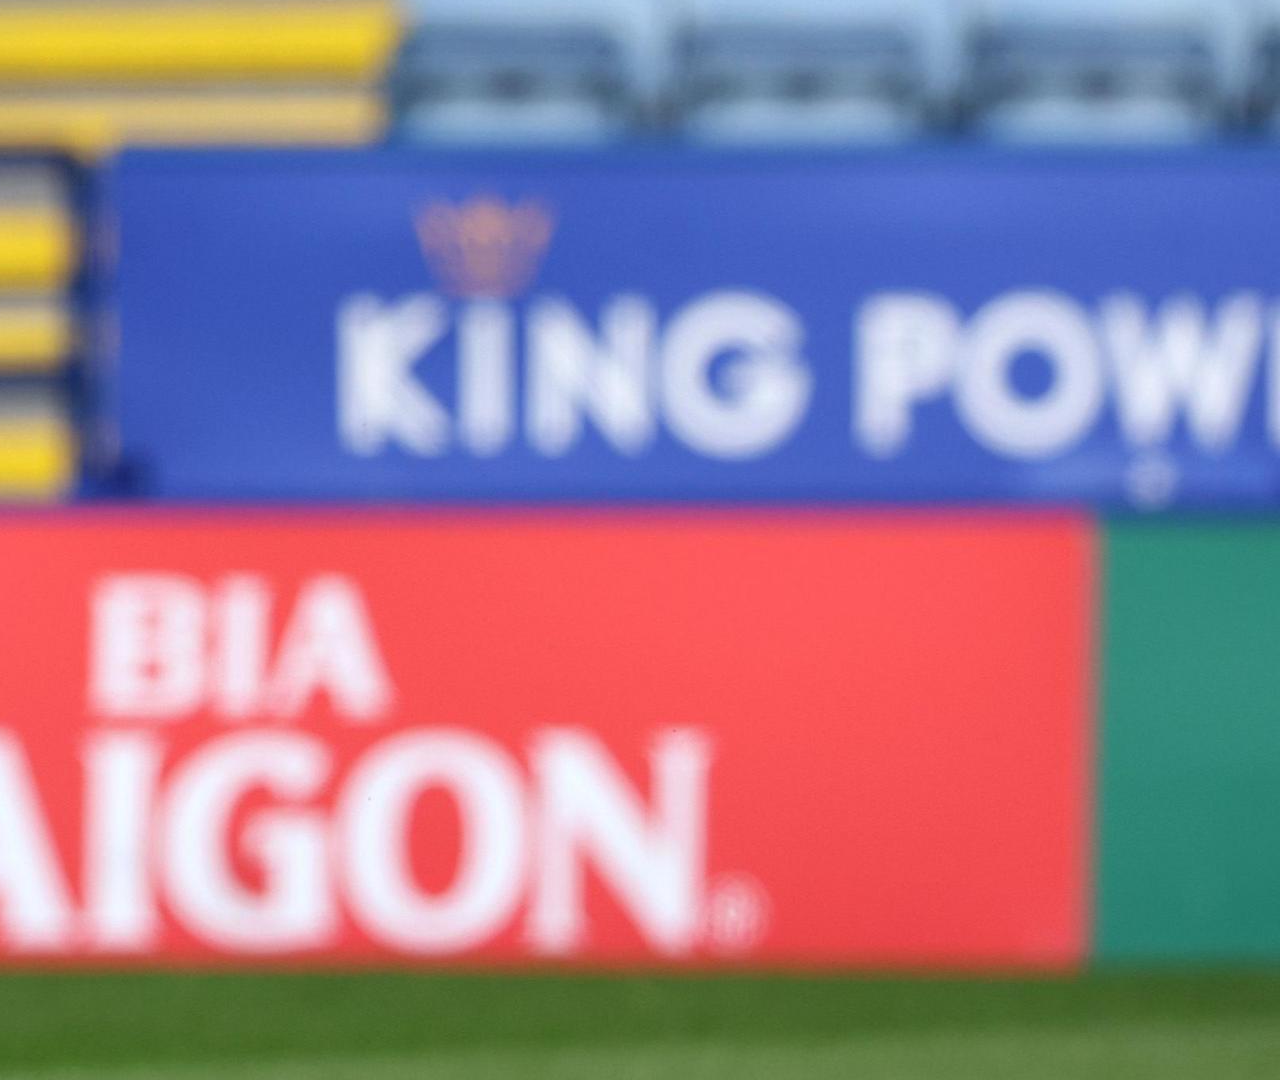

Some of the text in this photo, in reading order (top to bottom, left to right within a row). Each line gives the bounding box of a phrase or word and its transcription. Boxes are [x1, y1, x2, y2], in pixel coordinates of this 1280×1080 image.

[336, 288, 1280, 460] KING POW
[90, 574, 395, 722] BIA
